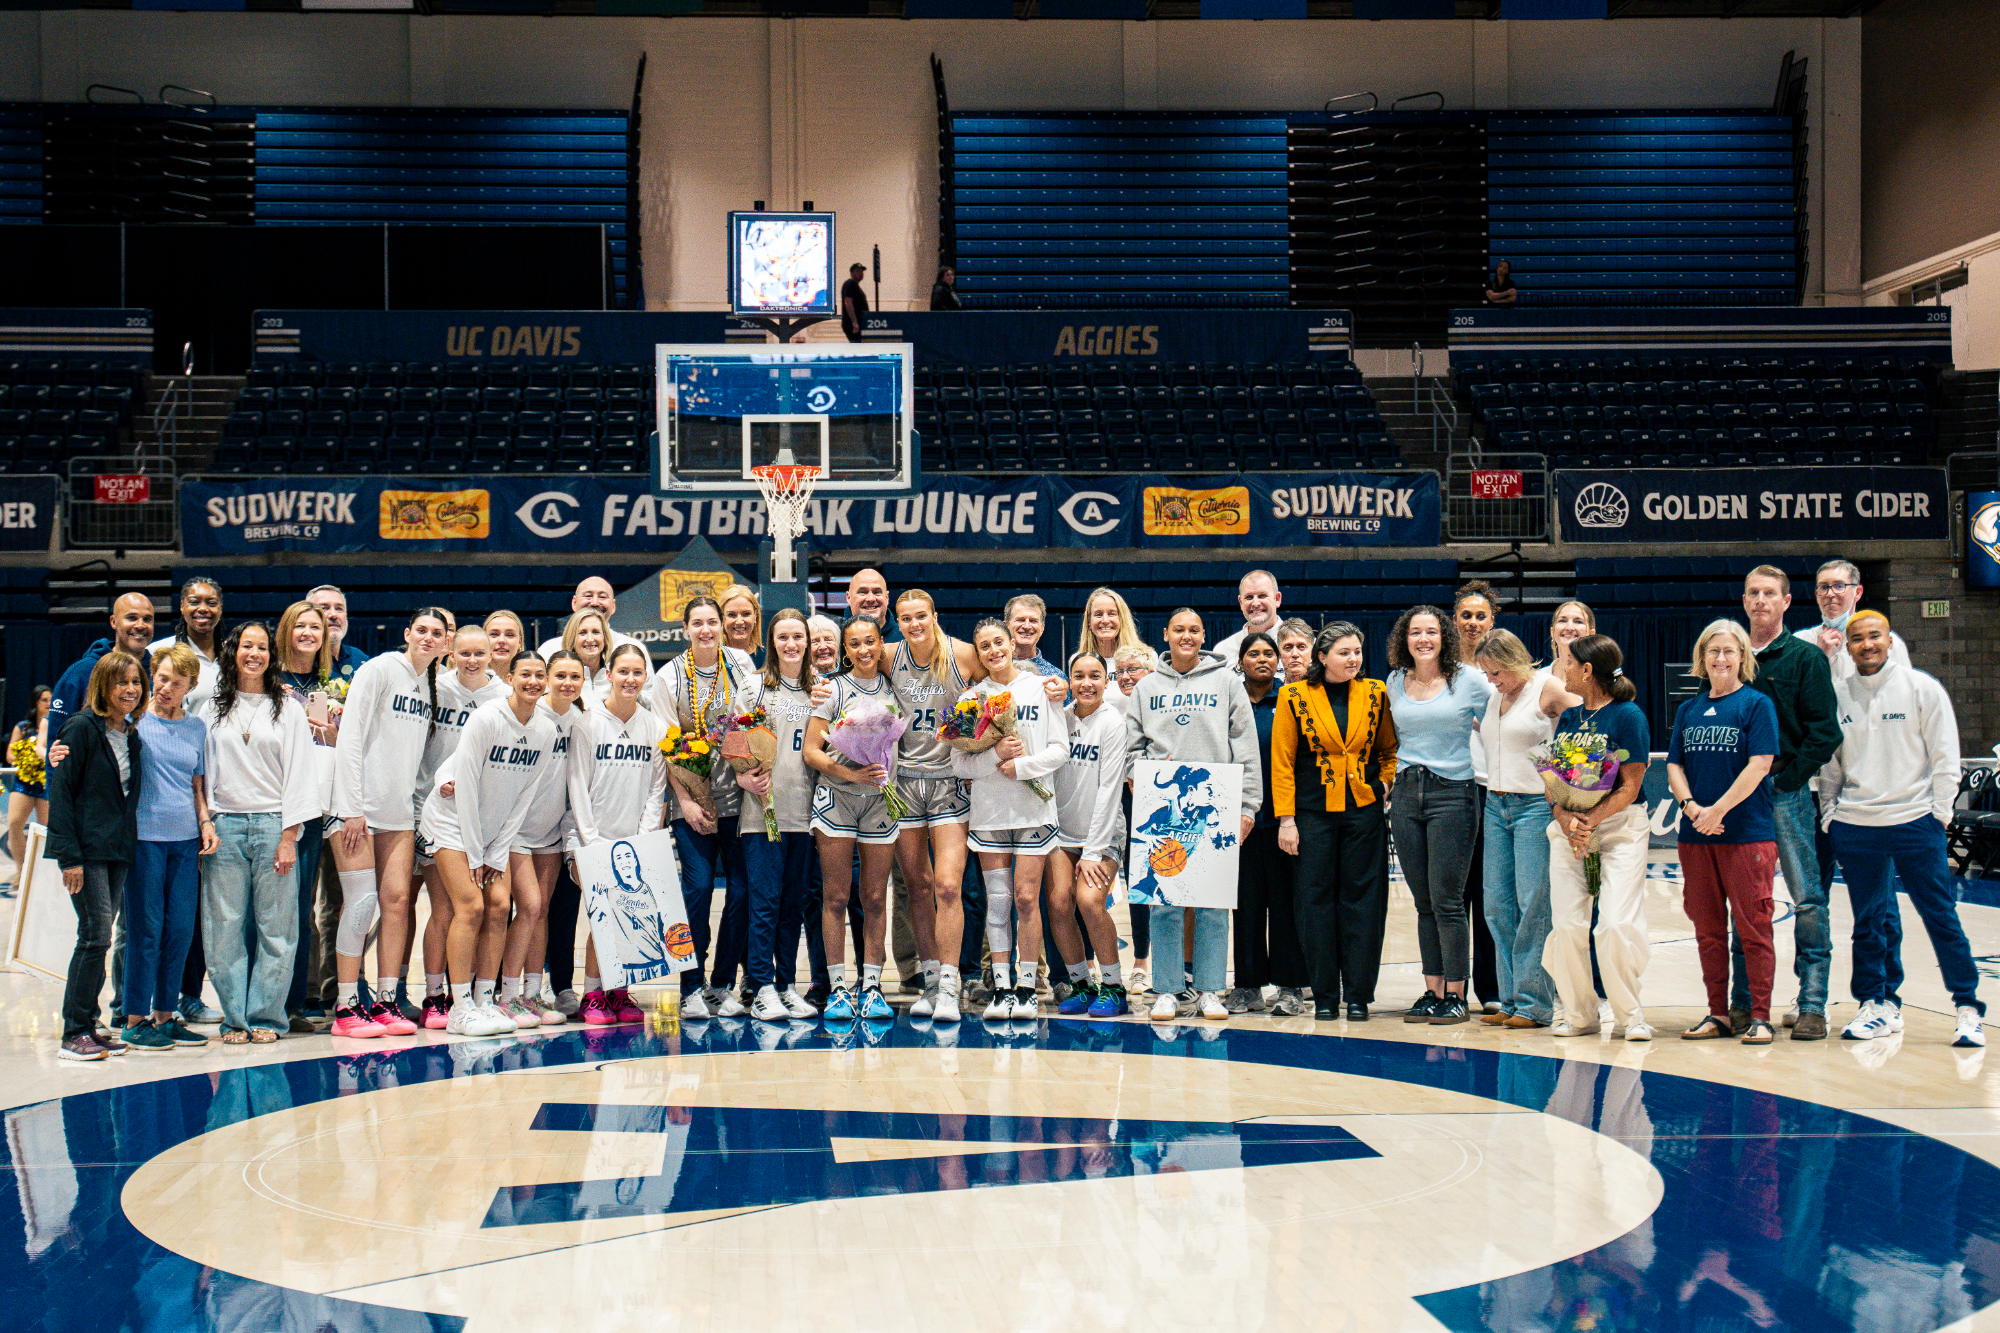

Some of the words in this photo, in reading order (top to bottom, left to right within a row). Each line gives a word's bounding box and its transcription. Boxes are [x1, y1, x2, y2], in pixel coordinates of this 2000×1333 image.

[126, 317, 148, 327] 202
[262, 318, 283, 327] 203
[867, 319, 888, 328] 204
[1323, 318, 1343, 327] 204
[1454, 317, 1475, 326] 205
[1927, 312, 1947, 321] 205
[446, 326, 485, 356] UC
[490, 326, 581, 356] DAVIS
[1053, 325, 1159, 356] AGGIES
[99, 479, 124, 489] NOT
[125, 479, 145, 489] AN
[1476, 475, 1500, 485] NOT
[1501, 475, 1518, 485] AN
[108, 489, 135, 499] EXIT
[1483, 485, 1509, 494] EXIT
[206, 490, 358, 527] SUDWERK
[1271, 485, 1415, 519] SUDWERK
[1643, 492, 1748, 520] GOLDEN
[1759, 491, 1843, 520] STATE
[1855, 489, 1930, 518] CIDER
[601, 494, 853, 536] FASTBRAK
[873, 491, 1038, 534] LOUNGE
[244, 524, 300, 539] BREWING
[1307, 519, 1361, 531] BREWING
[1927, 602, 1946, 616] EXIT
[900, 678, 947, 704] Aggies
[393, 694, 409, 713] UC
[1150, 695, 1167, 710] UC
[1172, 693, 1218, 708] DAVIS
[435, 707, 456, 725] UC
[912, 708, 936, 732] 25
[793, 729, 803, 751] 6
[1692, 726, 1740, 746] DAVIS
[488, 745, 509, 763] UC
[595, 743, 613, 760] UC
[614, 744, 652, 762] DAVIS
[1168, 830, 1203, 843] AGGIES
[632, 914, 639, 930] 6
